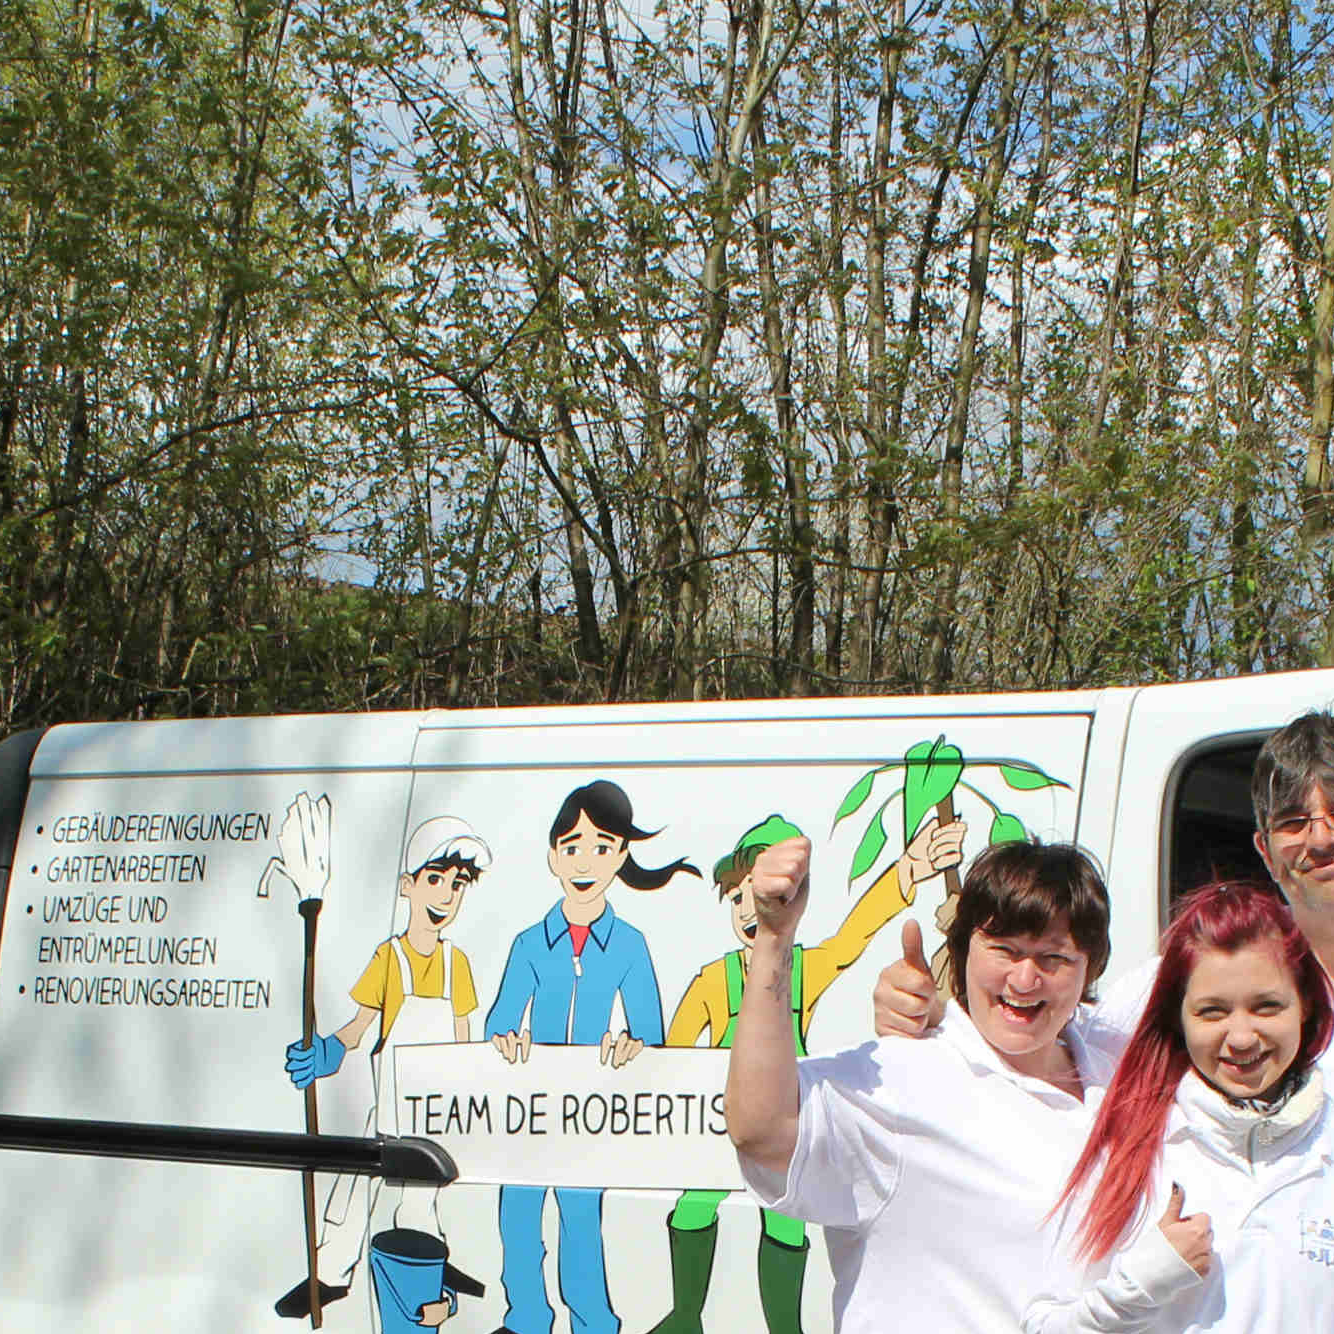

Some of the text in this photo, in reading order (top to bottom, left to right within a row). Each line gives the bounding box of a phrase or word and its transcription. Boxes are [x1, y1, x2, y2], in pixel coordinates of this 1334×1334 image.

[52, 811, 271, 843] GEBÄUDEREINIGUNGEN
[47, 854, 207, 882] GARTENARBEITEN
[42, 892, 168, 923] UMZÜGE UND
[37, 932, 218, 965] ENTRÜMPELUNGEN
[34, 976, 271, 1009] RENOVIERUNGSARBEITEN
[404, 1092, 729, 1135] TEAM DE ROBERTIS
